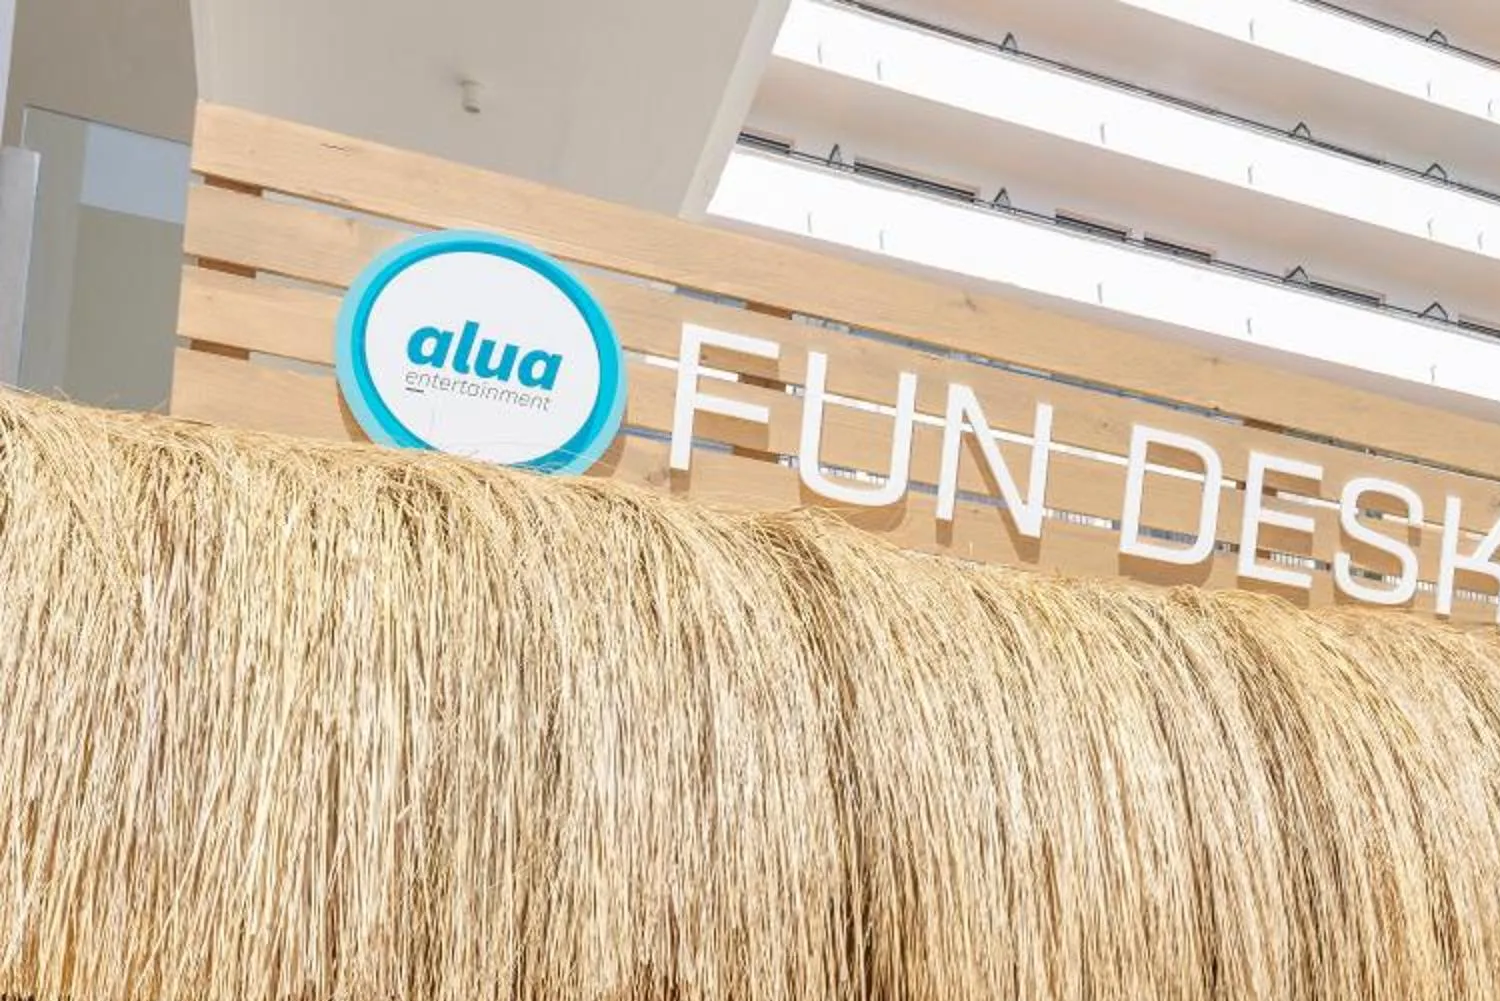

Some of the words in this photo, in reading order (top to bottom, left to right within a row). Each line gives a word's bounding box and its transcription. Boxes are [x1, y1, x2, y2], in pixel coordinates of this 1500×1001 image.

[405, 370, 552, 412] entertainment
[407, 319, 563, 391] alua
[669, 322, 1054, 540] FUN
